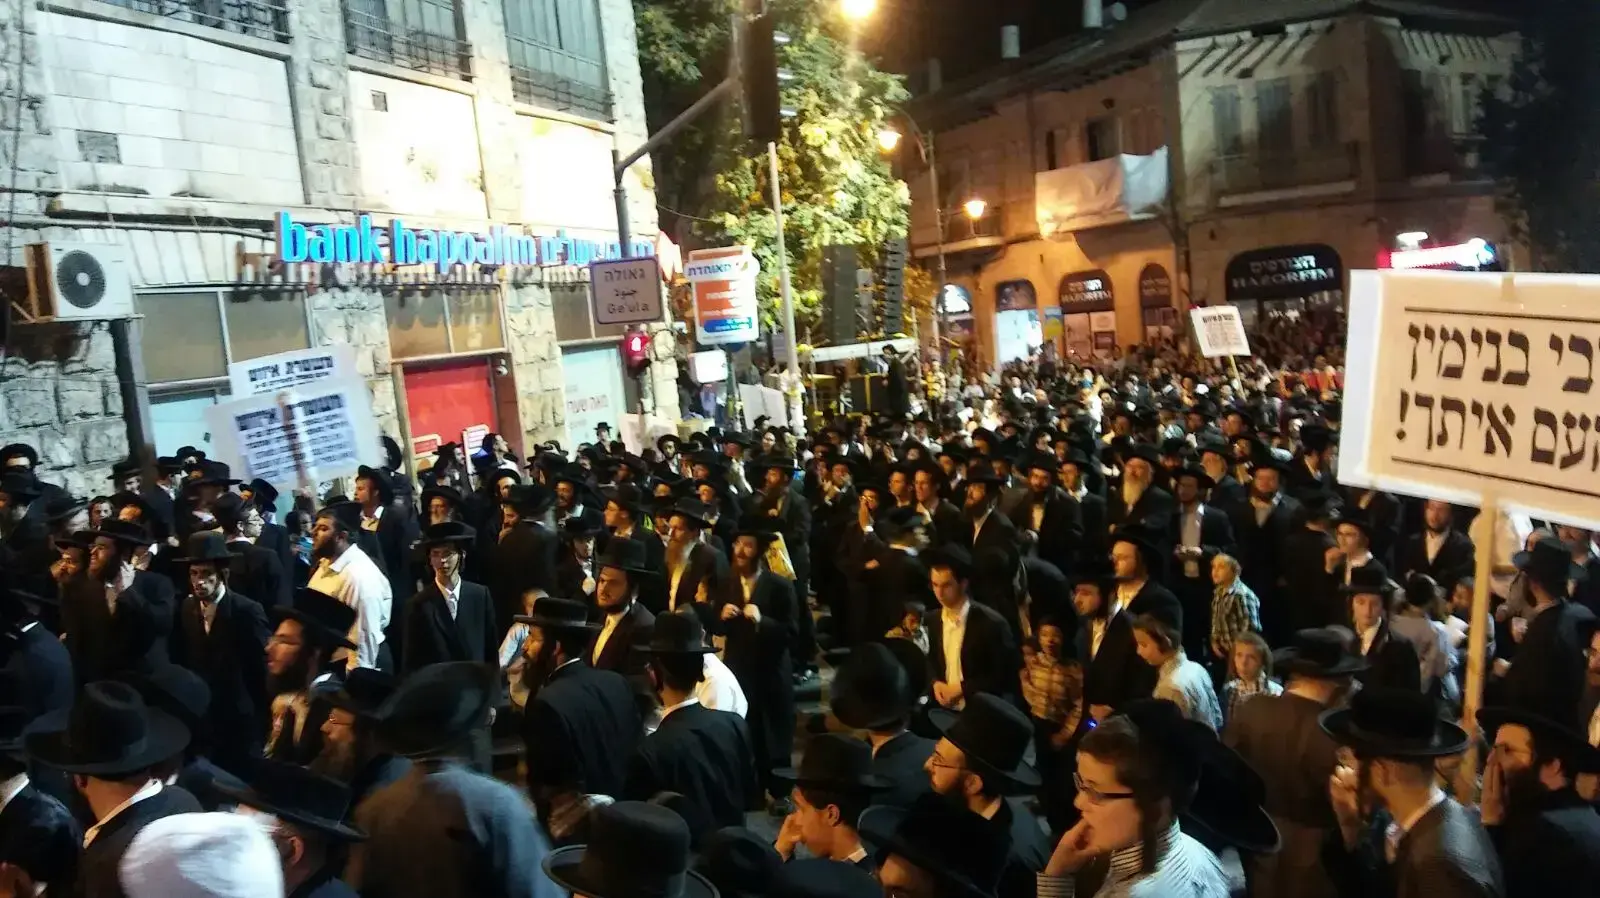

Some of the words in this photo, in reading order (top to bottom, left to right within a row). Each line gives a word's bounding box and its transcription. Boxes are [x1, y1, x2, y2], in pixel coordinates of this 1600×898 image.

[276, 208, 384, 263] bank
[390, 218, 537, 276] hapoalim
[604, 267, 646, 283] גאולה
[607, 301, 650, 315] Ge'ula
[1408, 321, 1531, 386] בנימין
[1549, 333, 1600, 394] בי
[1396, 388, 1517, 459] איתך!
